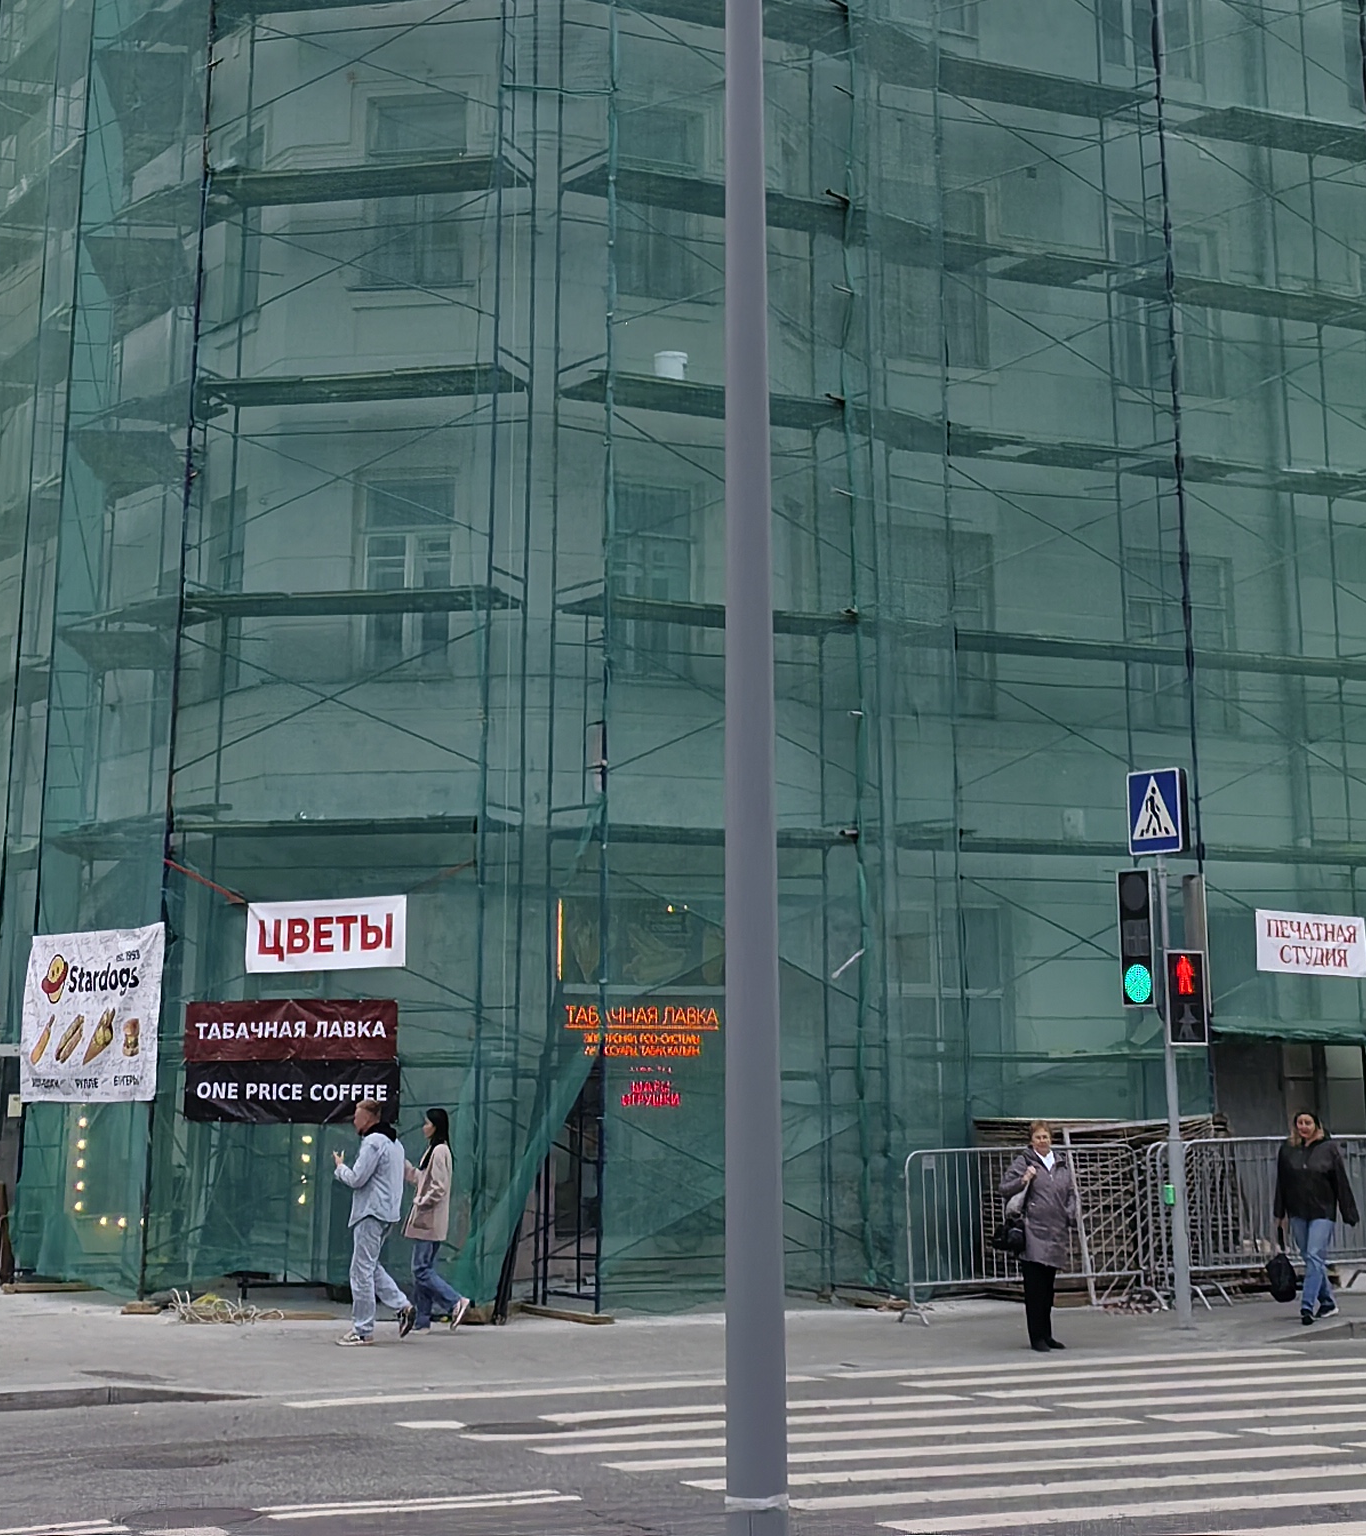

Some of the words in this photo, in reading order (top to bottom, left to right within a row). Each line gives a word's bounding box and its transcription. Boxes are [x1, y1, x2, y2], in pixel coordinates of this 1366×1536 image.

[258, 913, 393, 961] ЦВЕТЫ
[1266, 919, 1357, 943] ПЕЧАТНАЯ
[1279, 945, 1348, 968] СТУДИЯ
[68, 963, 140, 996] Stardogs
[566, 1005, 658, 1025] ТАБЧНАЯ
[662, 1005, 719, 1025] ЛАВКА
[195, 1021, 306, 1040] ТАБАЧНАЯ
[313, 1020, 387, 1039] ЛАВКА
[196, 1082, 238, 1099] ONE
[245, 1083, 302, 1100] PRICE
[310, 1084, 387, 1101] COFFEE
